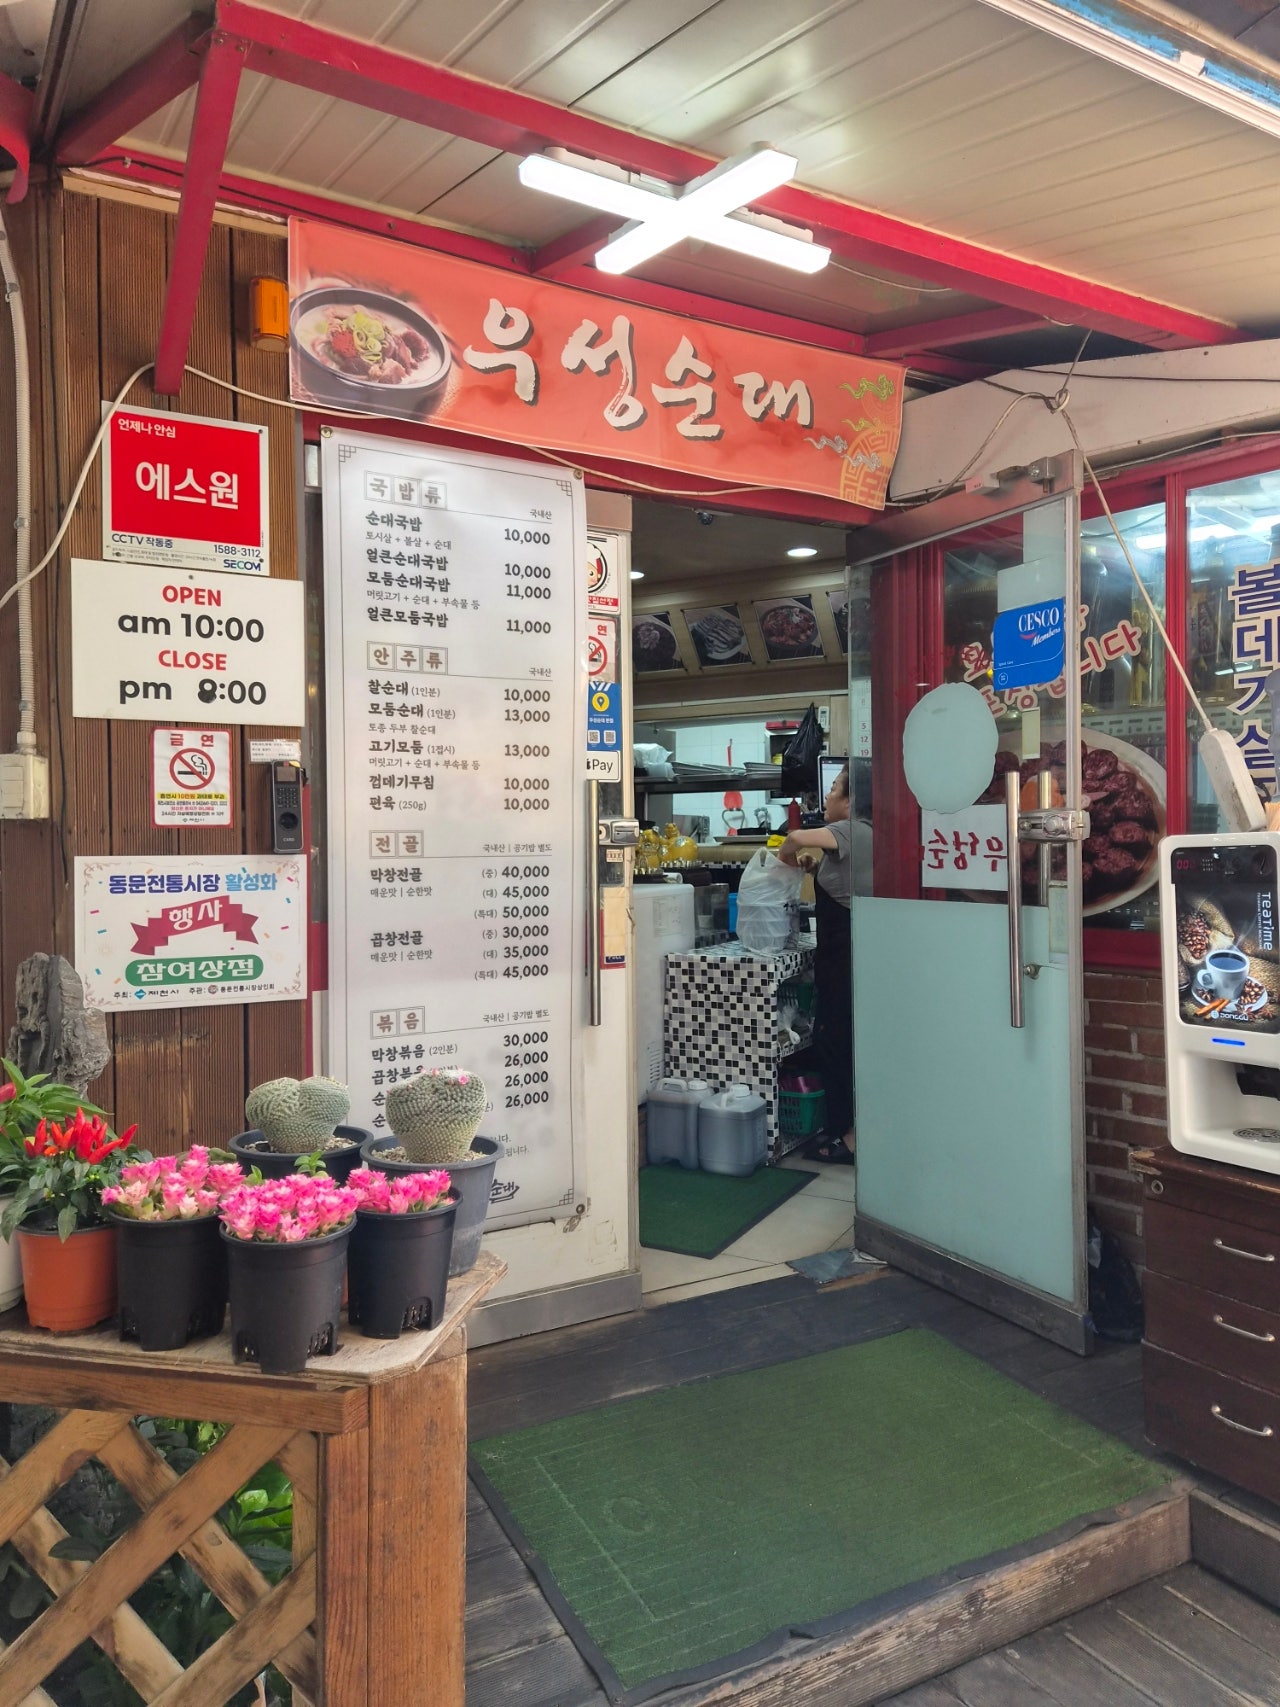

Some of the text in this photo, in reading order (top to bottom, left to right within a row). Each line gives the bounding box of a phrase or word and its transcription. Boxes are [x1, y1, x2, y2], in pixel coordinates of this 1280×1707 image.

[463, 298, 811, 440] 우성순대
[118, 418, 176, 438] 언제나 안심
[135, 461, 239, 510] 에스원
[369, 477, 442, 504] 국밥류
[530, 509, 552, 520] 국내산
[365, 510, 550, 545] 순대국밥 10,000
[112, 533, 173, 549] CCTV 작동중
[434, 539, 451, 550] 순대
[214, 544, 261, 558] 1588-3112
[223, 559, 261, 571] SECOM
[366, 548, 551, 579] 얼큰순대국밥 10,000
[366, 570, 551, 600] 모둠순대국밥 11,000
[162, 585, 222, 607] OPEN
[412, 594, 430, 605] 순대
[471, 600, 480, 610] 등
[118, 613, 264, 643] am 10:00
[367, 607, 551, 634] 얼큰모둠국밥 11,000
[1018, 607, 1060, 632] CESCO
[1031, 627, 1062, 648] Members
[158, 649, 227, 671] CLOSE
[374, 647, 443, 670] 안주류
[529, 667, 552, 677] 국내산
[119, 679, 171, 704] pm
[368, 679, 550, 703] 찰순대 (1인분) 10,000
[368, 702, 550, 723] 모둠순대 (1인분) 13,000
[368, 723, 436, 735] 토종 두부 찰순대
[369, 740, 550, 758] 고기모둠 (1접시) 13,000
[414, 758, 431, 769] 순대
[442, 759, 469, 770] 부속물
[471, 761, 480, 770] 등
[592, 759, 613, 774] Pay
[369, 775, 550, 792] 껍데기무침 10,000
[369, 796, 550, 812] 편육 (250g) 10,000
[375, 835, 419, 854] 전골
[483, 844, 505, 853] 국내산
[108, 872, 278, 895] 동문전통시장 활성화
[370, 866, 549, 884] 막창전골 (중) 40,000
[370, 886, 432, 898] 매운맛 순한맛
[482, 885, 549, 900] (대) 45,000
[169, 899, 223, 931] 행사
[474, 905, 549, 919] (특대) 50,000
[370, 925, 549, 948] 곱창전골 (중) 30,000
[370, 950, 432, 963] 매운맛 순한맛
[483, 945, 548, 960] (대) 35,000
[137, 958, 254, 982] 참여상점
[474, 964, 548, 981] (특대) 45,000
[377, 1011, 419, 1033] 볶음
[483, 1009, 549, 1023] 국내산 공기밥 별도
[371, 1031, 548, 1063] 막창볶음 (2인분) 30,000
[504, 1051, 548, 1067] 26,000
[505, 1071, 548, 1087] 26,000
[505, 1091, 549, 1107] 26,000
